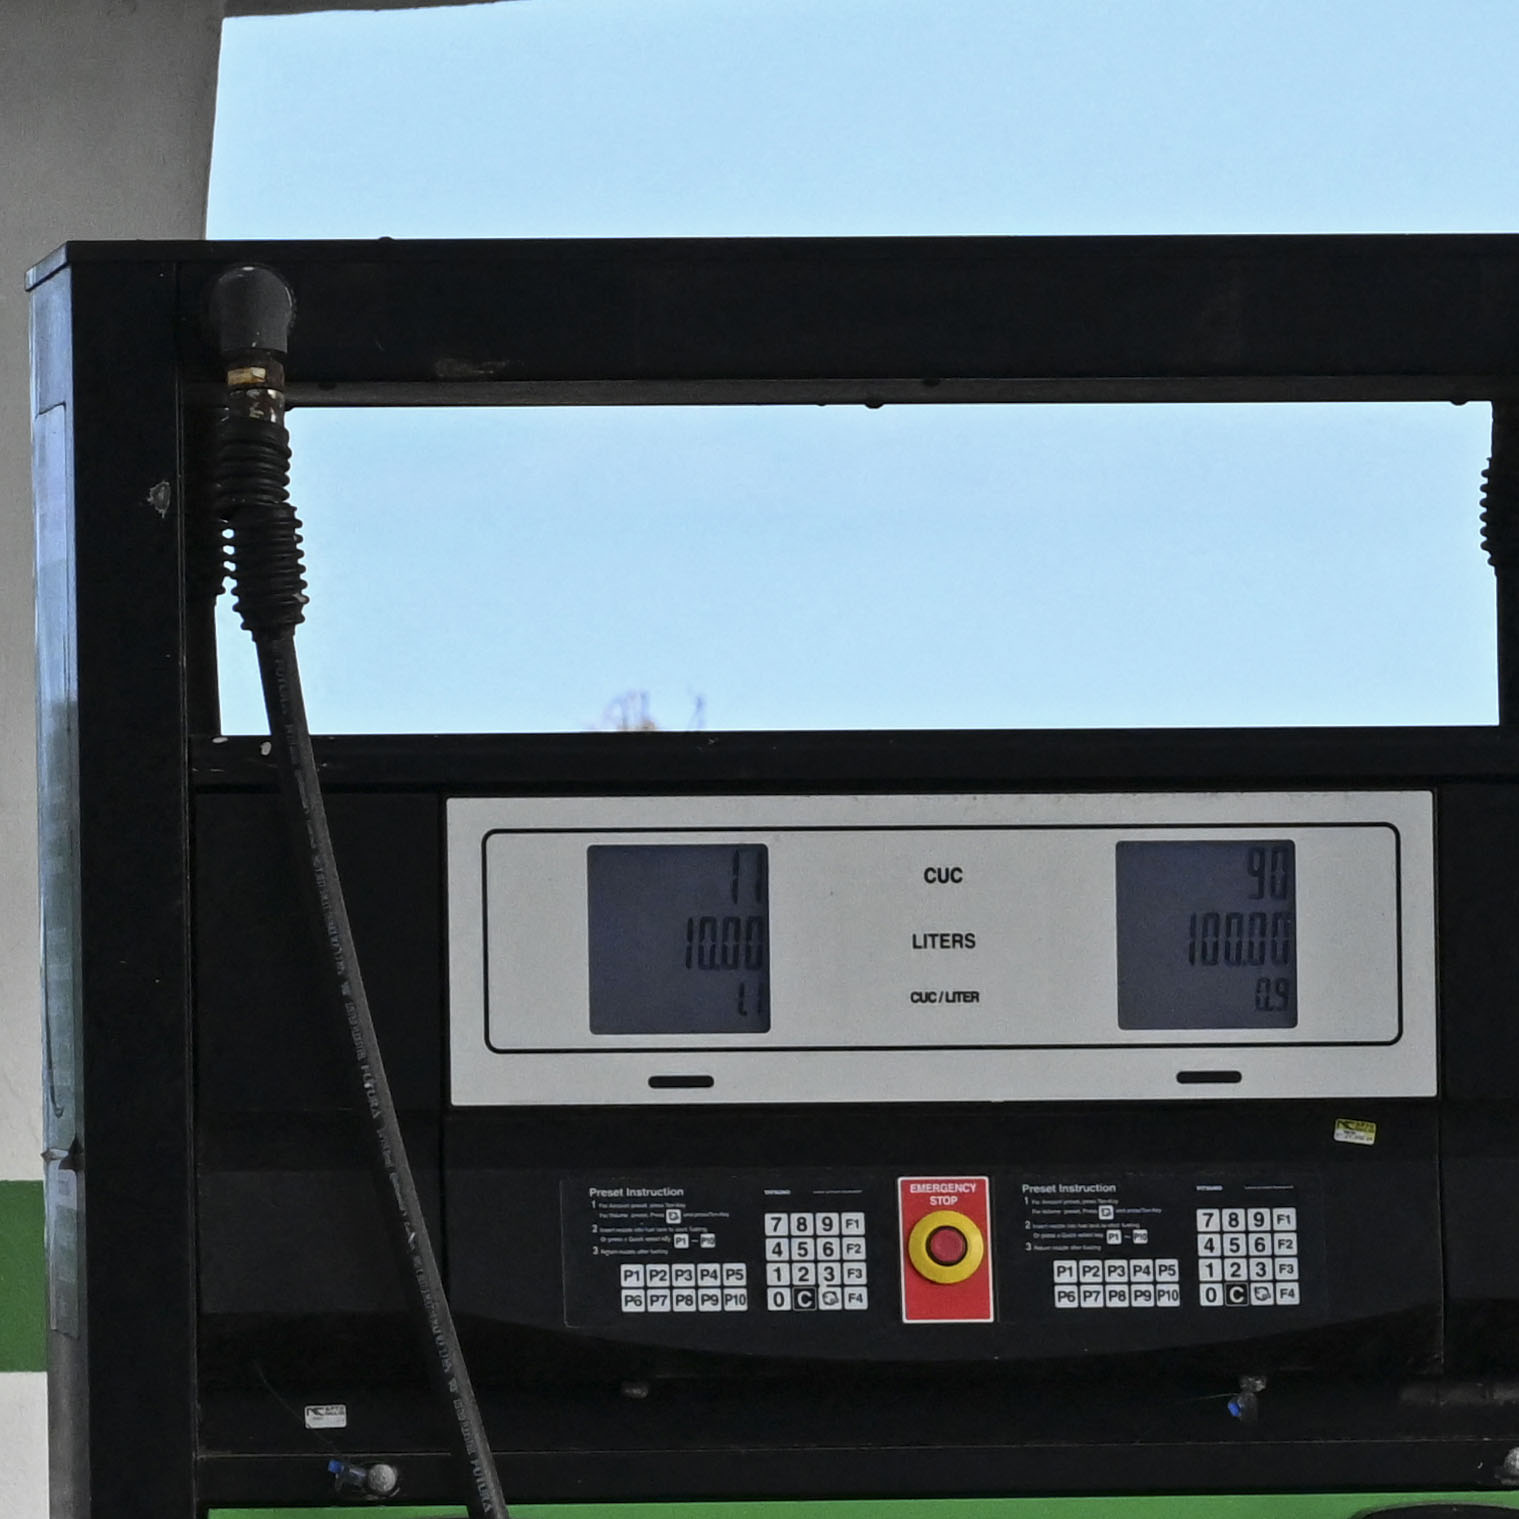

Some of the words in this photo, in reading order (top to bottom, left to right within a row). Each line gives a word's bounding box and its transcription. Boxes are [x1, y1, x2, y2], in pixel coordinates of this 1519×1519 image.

[924, 866, 963, 884] CUC
[1247, 847, 1289, 900] 90
[912, 933, 976, 949] LITERS
[589, 1188, 624, 1197] Preset
[626, 1187, 684, 1196] Instruction
[910, 1182, 976, 1193] EMERGENCY
[1022, 1184, 1056, 1193] Preset
[1059, 1184, 1116, 1193] Instruction
[930, 1196, 958, 1206] STOP
[771, 1217, 781, 1232] 7
[797, 1217, 807, 1232] 8
[822, 1216, 833, 1232] 9
[846, 1219, 859, 1229] F1
[1203, 1213, 1213, 1228] 7
[1228, 1212, 1239, 1227] 8
[1254, 1212, 1264, 1227] 9
[1277, 1215, 1290, 1224] F1
[772, 1242, 782, 1257] 4
[797, 1242, 808, 1257] 5
[823, 1241, 834, 1257] 6
[847, 1244, 861, 1254] F2
[1204, 1238, 1215, 1253] 4
[1230, 1238, 1240, 1253] 5
[1255, 1237, 1266, 1252] 6
[1278, 1239, 1293, 1249] F2
[624, 1269, 640, 1281] P1
[650, 1269, 667, 1281] P2
[675, 1269, 692, 1281] P3
[701, 1269, 718, 1280] P4
[726, 1269, 743, 1280] P5
[773, 1267, 781, 1282] 1
[798, 1266, 809, 1281] 2
[824, 1266, 835, 1281] 3
[848, 1269, 862, 1278] F3
[1057, 1265, 1072, 1277] P1
[1083, 1265, 1100, 1277] P2
[1108, 1265, 1125, 1277] P3
[1133, 1265, 1151, 1276] P4
[1158, 1265, 1176, 1276] P5
[1205, 1263, 1213, 1277] 1
[1230, 1262, 1241, 1277] 2
[1256, 1262, 1266, 1277] 3
[1279, 1264, 1294, 1274] F3
[625, 1295, 642, 1306] P6
[650, 1295, 668, 1306] P7
[676, 1295, 693, 1306] P8
[701, 1294, 719, 1306] P9
[725, 1294, 746, 1305] P10
[774, 1292, 784, 1307] 0
[797, 1291, 812, 1307] C
[849, 1293, 863, 1303] F4
[1058, 1291, 1075, 1302] P6
[1084, 1291, 1101, 1302] P7
[1109, 1290, 1126, 1302] P8
[1134, 1290, 1151, 1302] P9
[1158, 1290, 1178, 1302] P10
[1206, 1287, 1216, 1302] 0
[1230, 1287, 1244, 1303] C
[1280, 1289, 1295, 1299] F4
